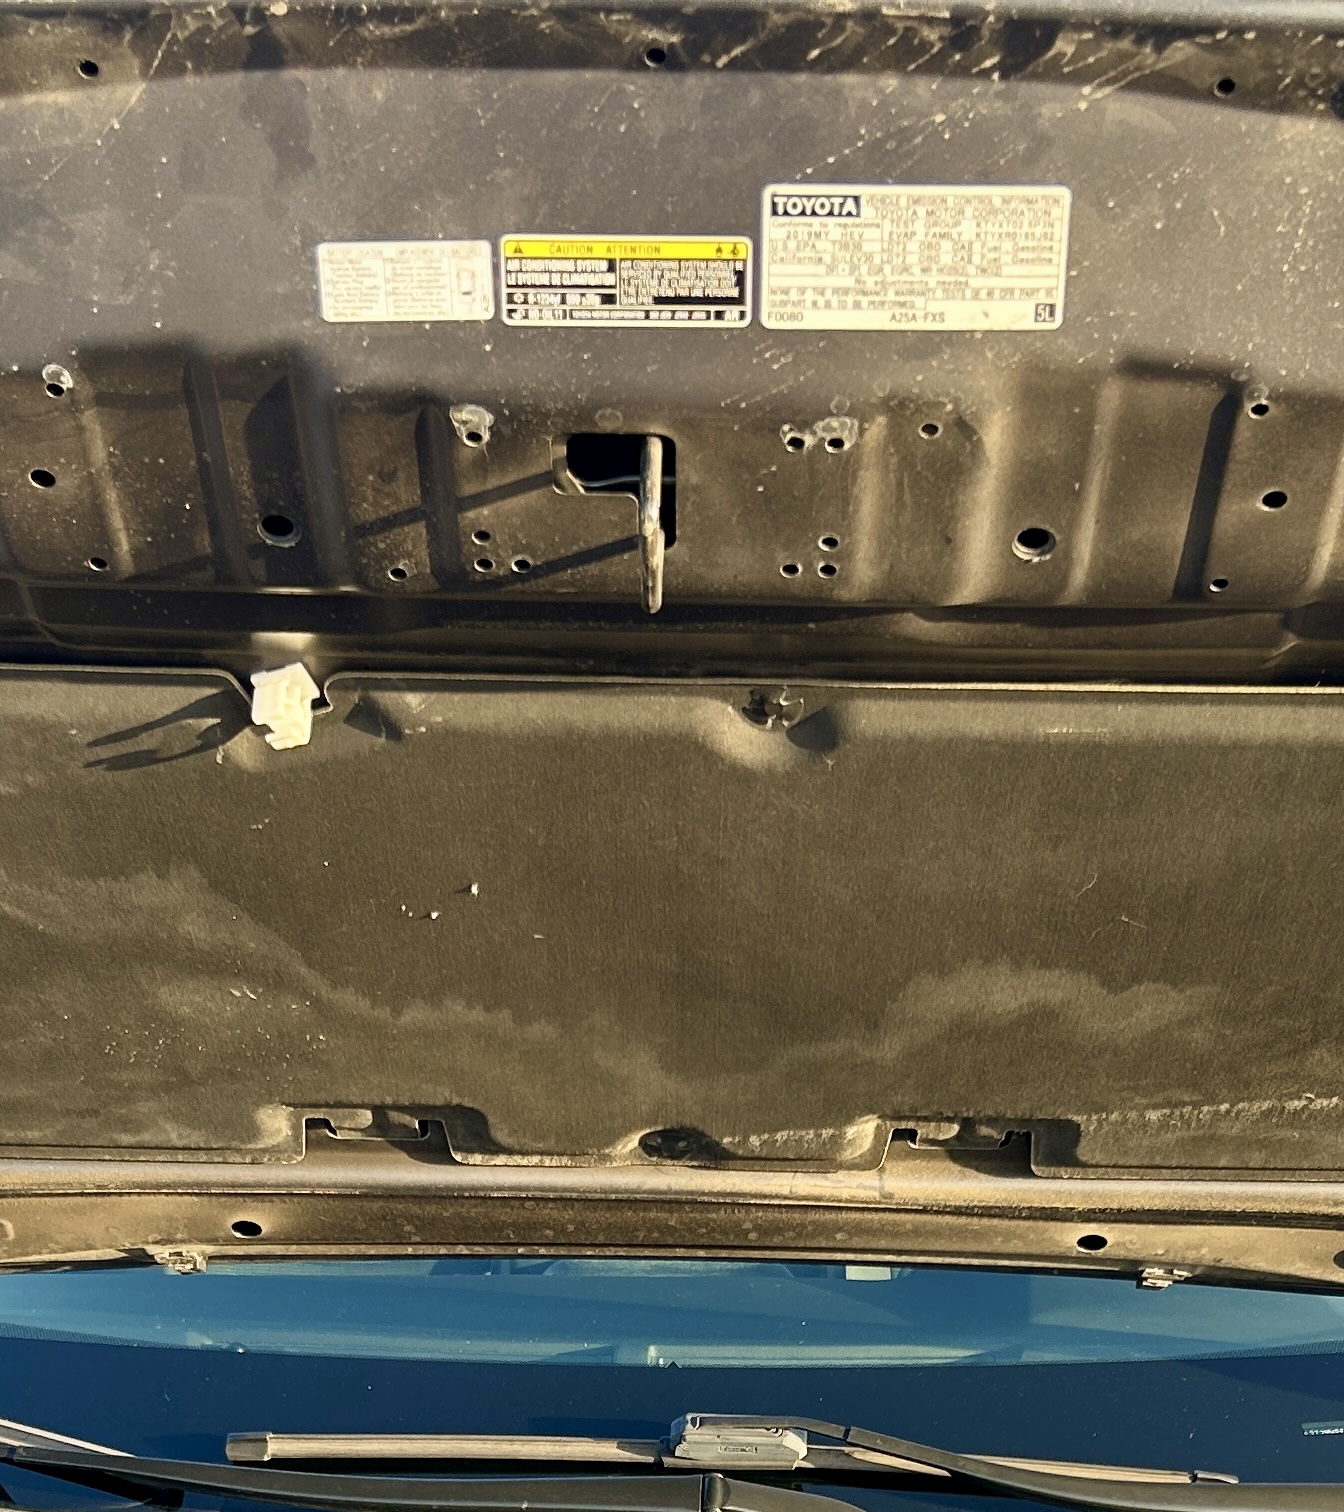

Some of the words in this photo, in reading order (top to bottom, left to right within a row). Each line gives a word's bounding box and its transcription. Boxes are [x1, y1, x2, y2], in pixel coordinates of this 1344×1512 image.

[773, 196, 857, 216] TOYOTA
[865, 196, 900, 206] VEHICLE
[907, 196, 947, 207] EMISSION
[953, 196, 993, 207] CONTROL
[1002, 196, 1060, 207] INFORMATION
[875, 207, 918, 218] TOYOTA
[925, 208, 965, 219] MOTOR
[973, 208, 1051, 219] CORPORATION
[890, 219, 916, 229] TEST
[924, 220, 961, 229] GROUP
[786, 230, 830, 239] 2019MY
[841, 230, 864, 239] HEV
[889, 231, 917, 240] EVAP
[925, 231, 962, 240] FAMILY
[549, 244, 594, 255] CAUTION
[606, 244, 661, 255] ATTENTION
[1036, 304, 1056, 323] 5L
